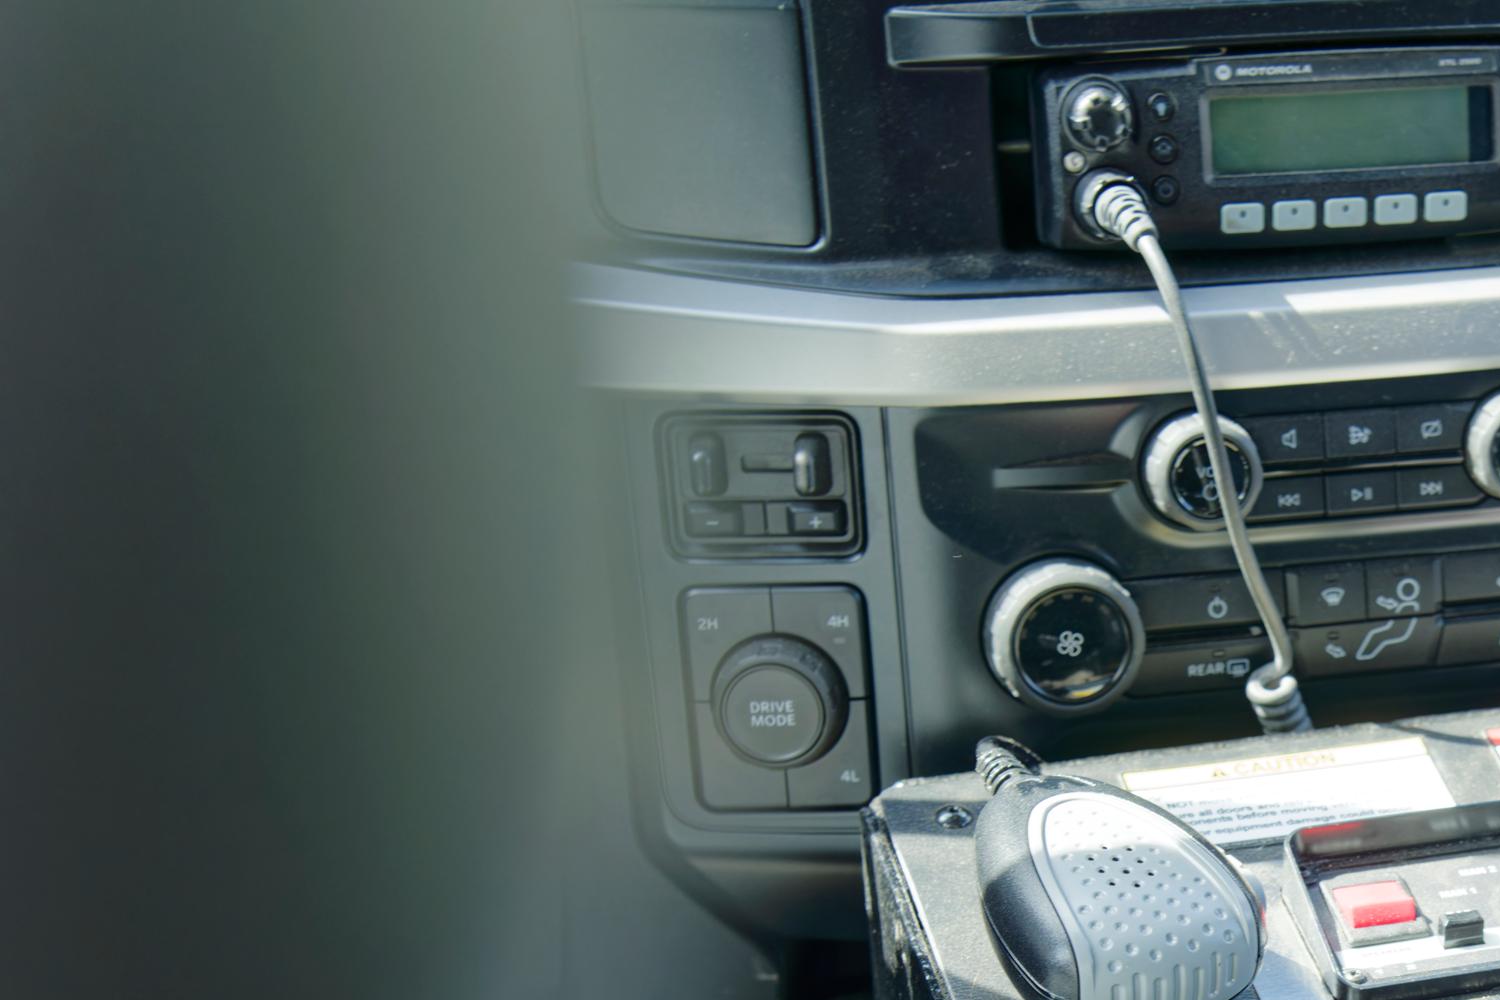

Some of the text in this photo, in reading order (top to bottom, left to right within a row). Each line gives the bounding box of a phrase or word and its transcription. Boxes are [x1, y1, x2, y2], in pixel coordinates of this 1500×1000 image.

[1235, 64, 1313, 77] MOTOROLA
[697, 617, 719, 632] 2H
[827, 614, 849, 629] 4H
[1187, 661, 1227, 678] REAR
[749, 700, 795, 715] DRIVE
[750, 714, 796, 728] MODE
[1233, 752, 1337, 776] CAUTION
[840, 769, 861, 783] 4L
[1286, 813, 1336, 826] damage
